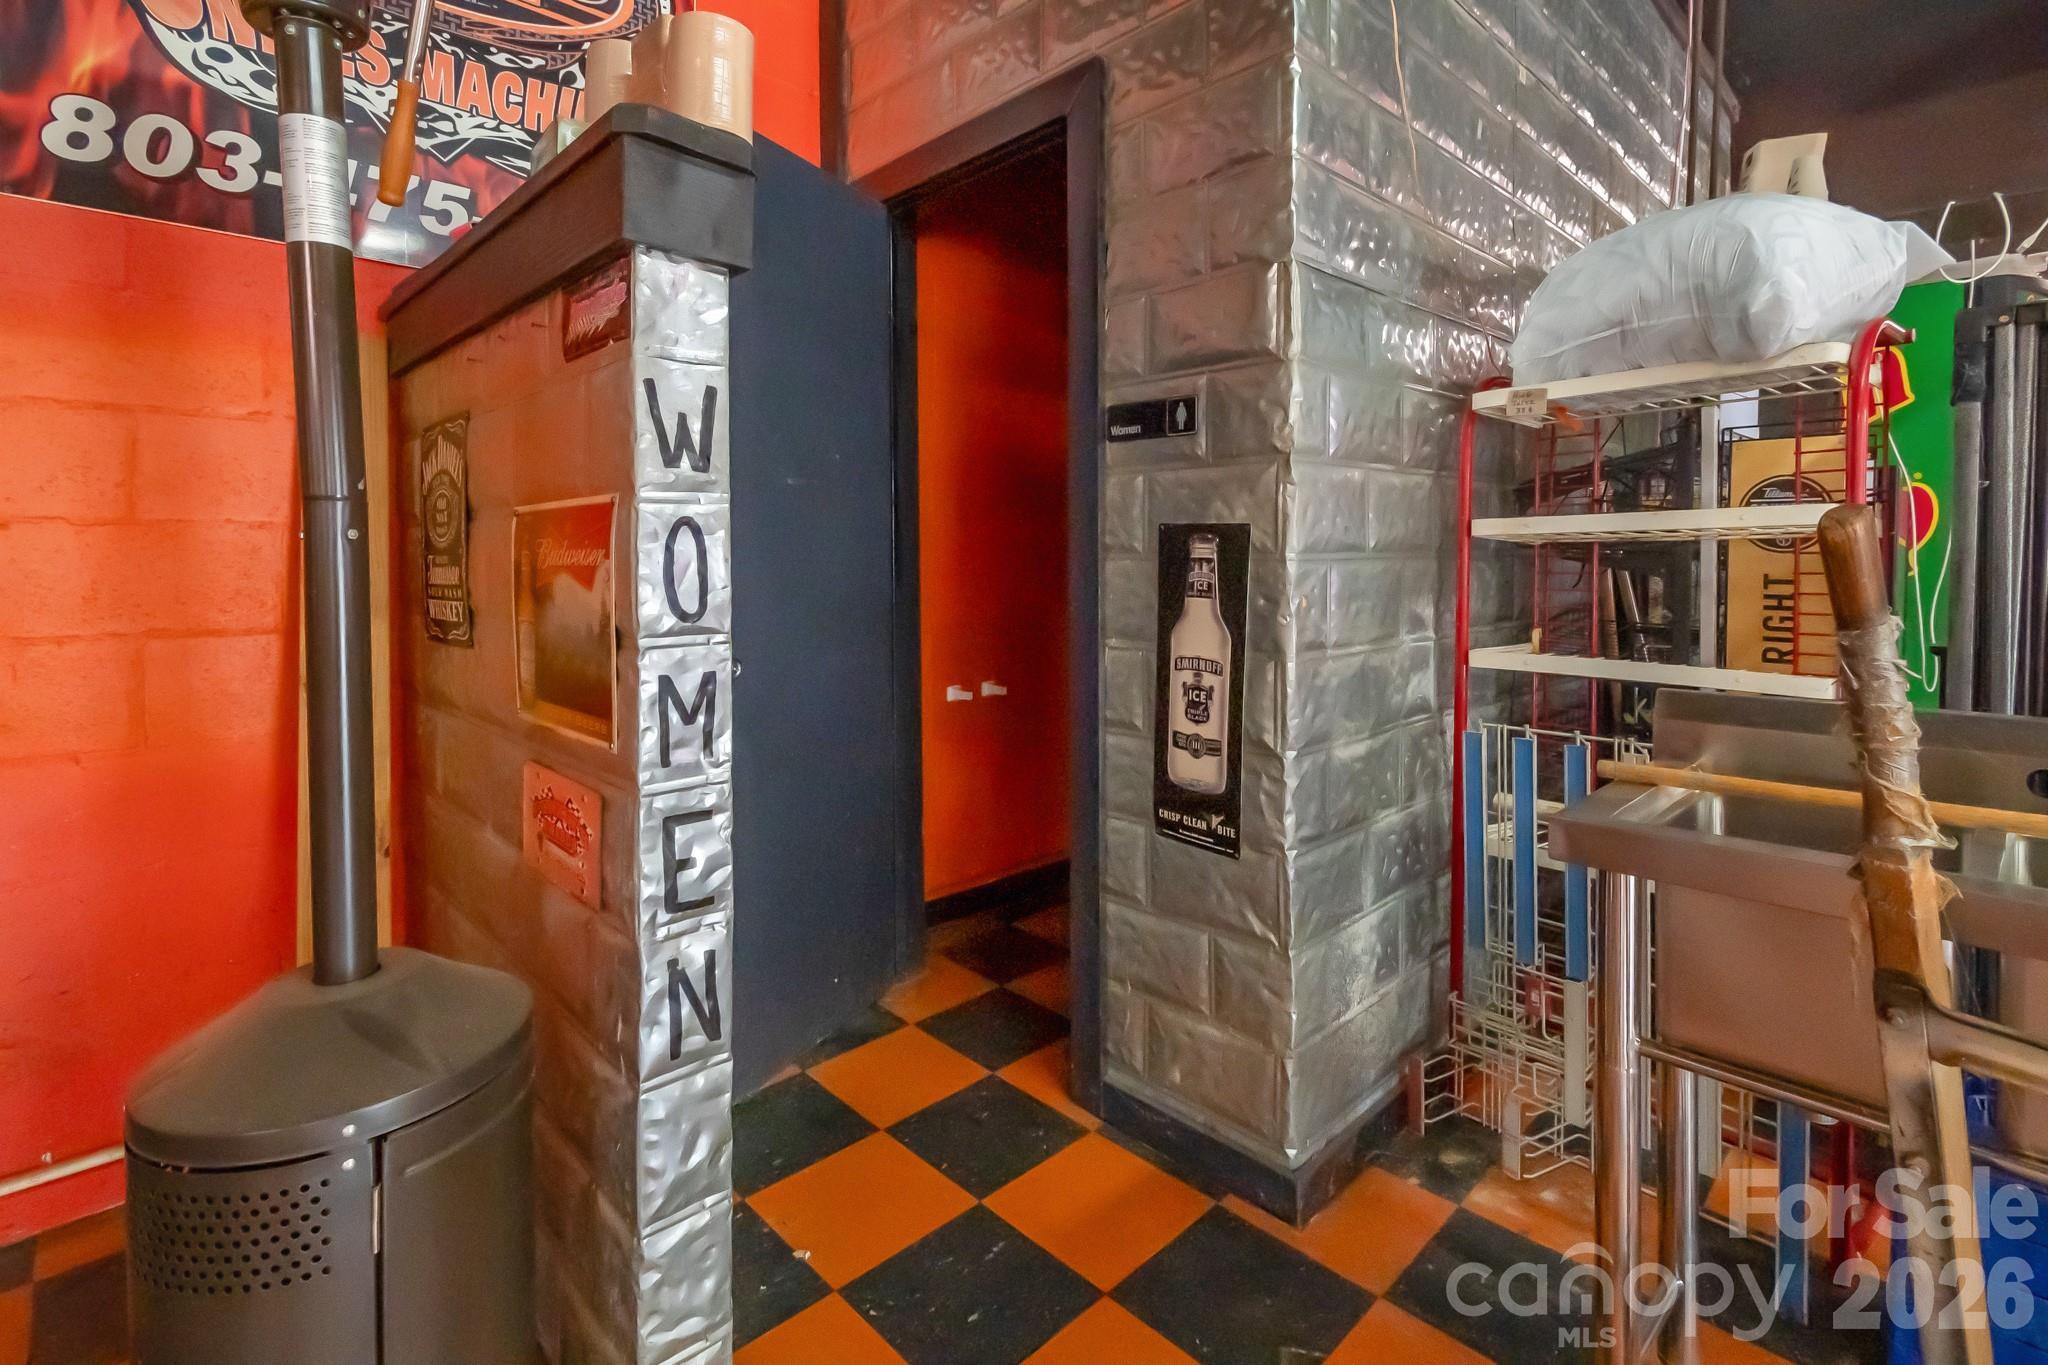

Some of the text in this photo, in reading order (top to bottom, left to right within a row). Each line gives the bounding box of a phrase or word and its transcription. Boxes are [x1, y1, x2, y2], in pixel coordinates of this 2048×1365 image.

[421, 48, 586, 132] MACHI
[1110, 425, 1141, 436] Women
[536, 538, 606, 570] Budweiser
[428, 599, 464, 622] WHISKEY
[1762, 573, 1795, 665] RIGHT
[1176, 657, 1223, 676] SMIRNOFF
[1188, 689, 1207, 703] ICE
[643, 377, 722, 1061] WOMEN
[1158, 808, 1181, 823] CRISP
[1183, 815, 1207, 831] CLEAN
[1217, 825, 1236, 839] BITE
